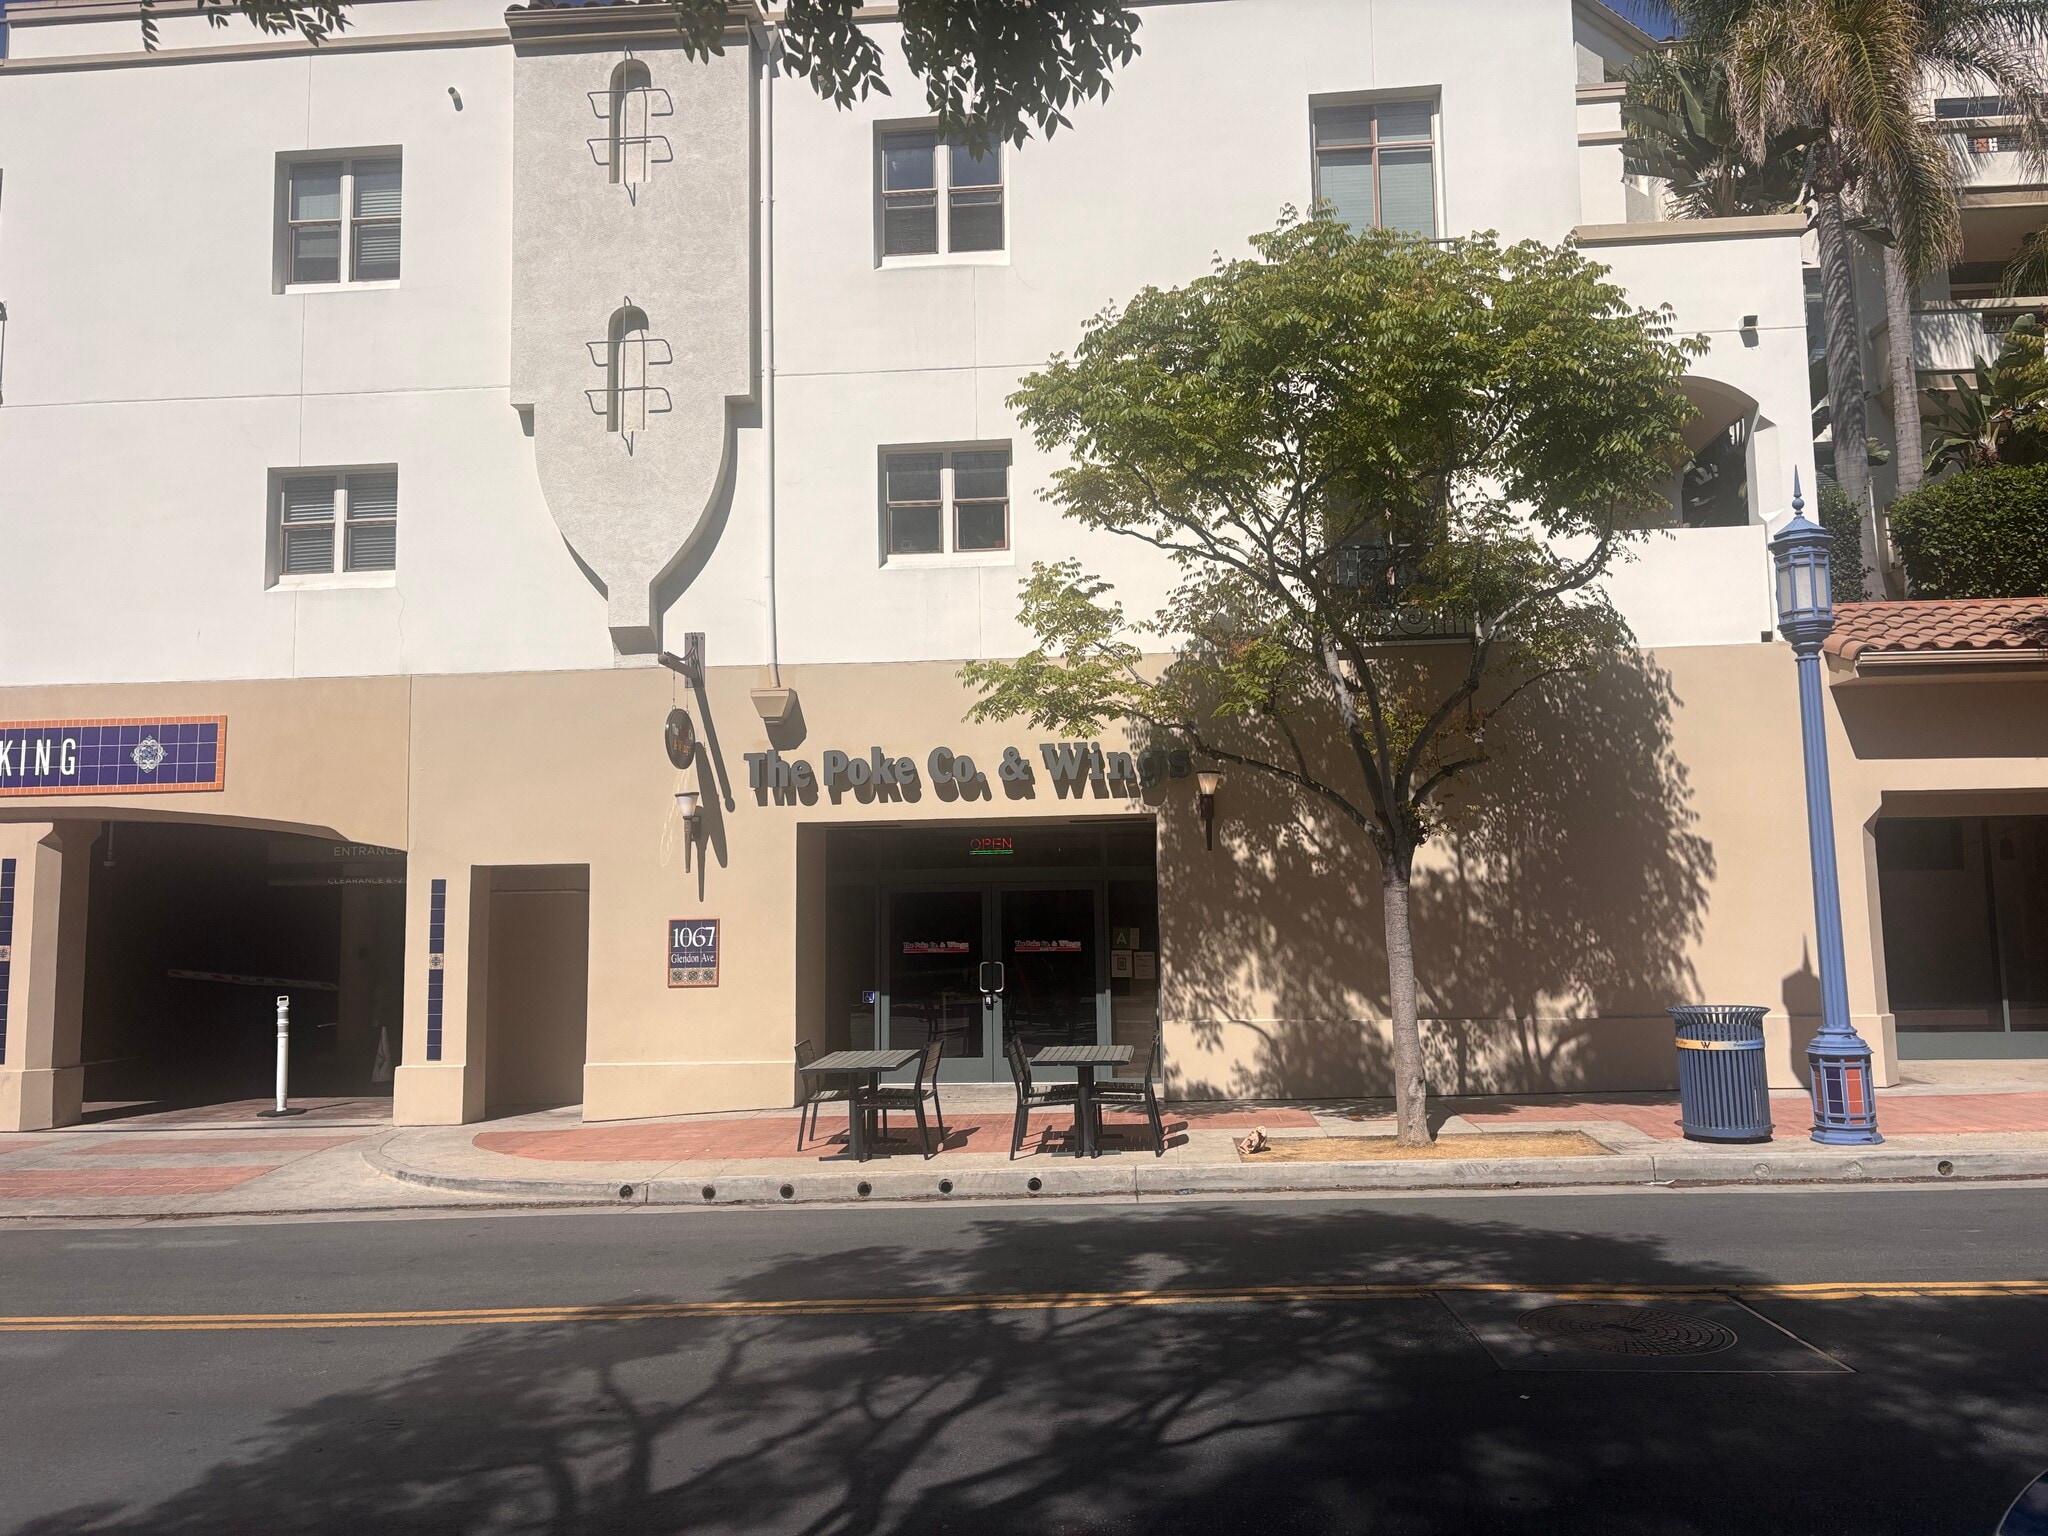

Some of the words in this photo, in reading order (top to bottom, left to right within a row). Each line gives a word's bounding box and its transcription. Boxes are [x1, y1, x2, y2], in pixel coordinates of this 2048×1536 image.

[0, 738, 76, 777] KING
[744, 750, 812, 788] The
[824, 747, 916, 786] Poke
[928, 747, 986, 784] Co.
[998, 747, 1030, 782] &
[1040, 741, 1192, 788] Wings
[970, 837, 1012, 850] OPEN
[673, 926, 716, 948] 1067
[1116, 932, 1127, 944] A
[671, 953, 699, 963] Glendon
